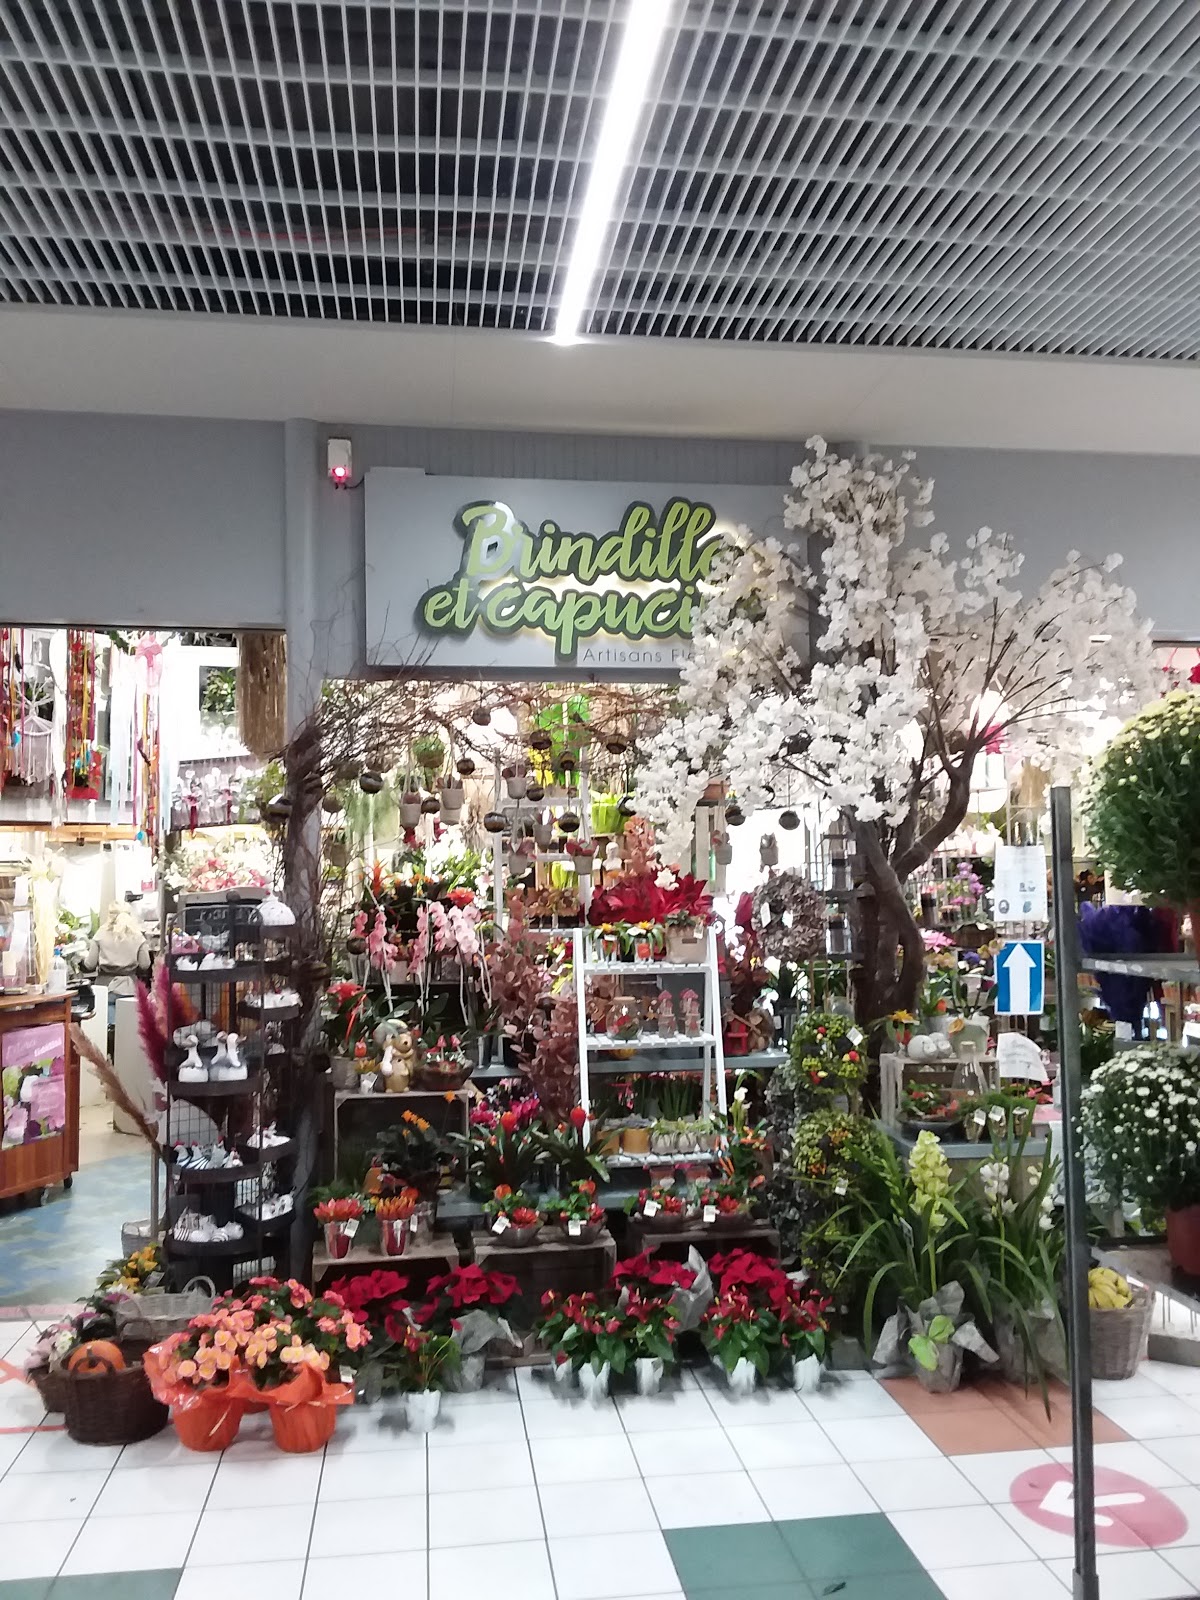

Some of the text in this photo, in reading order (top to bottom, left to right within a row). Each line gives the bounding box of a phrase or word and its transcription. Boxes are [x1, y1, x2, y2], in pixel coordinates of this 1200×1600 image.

[424, 578, 704, 654] et capuci
[583, 648, 662, 662] Artisans
